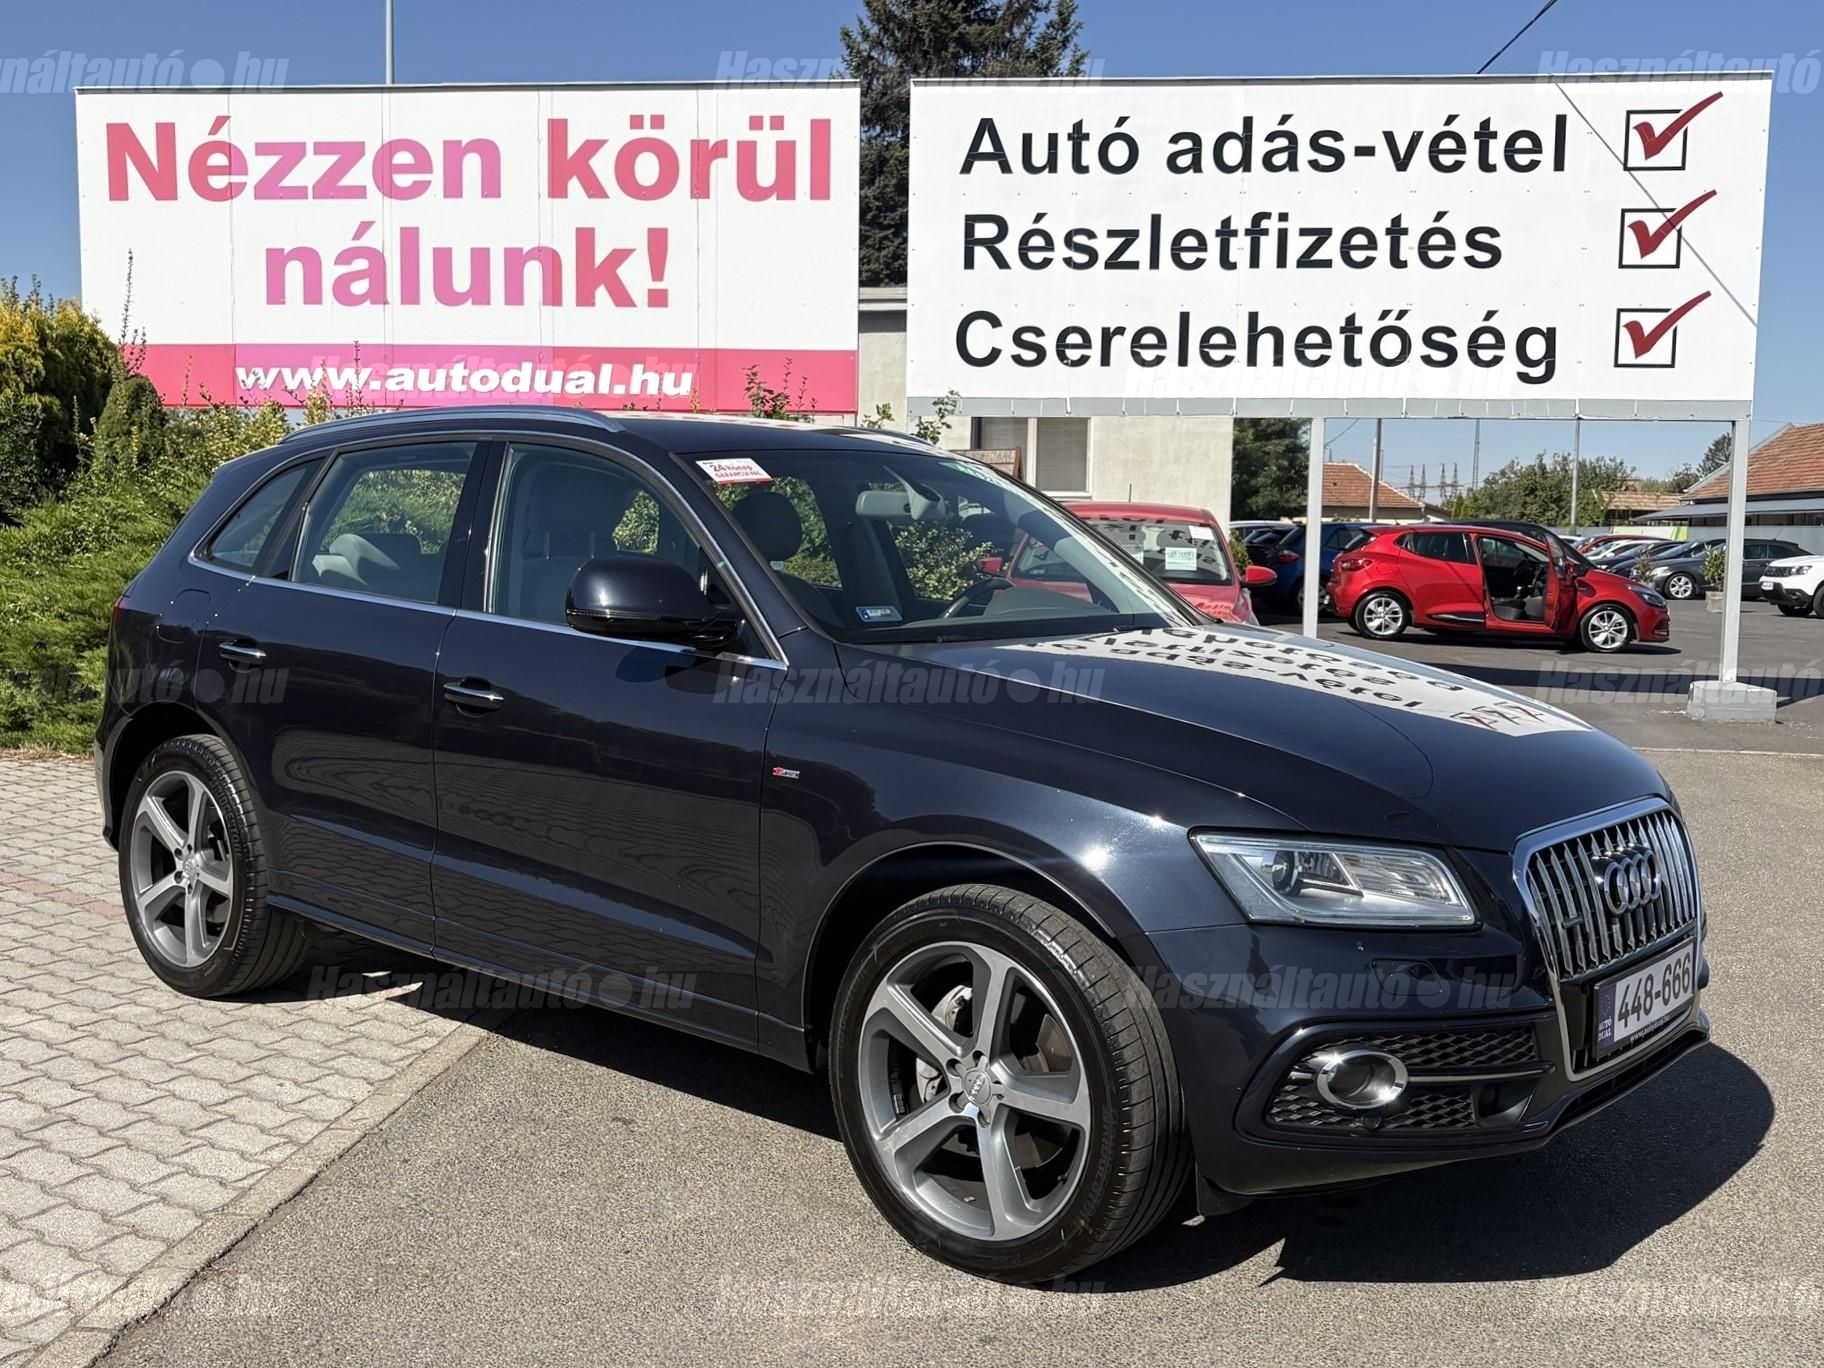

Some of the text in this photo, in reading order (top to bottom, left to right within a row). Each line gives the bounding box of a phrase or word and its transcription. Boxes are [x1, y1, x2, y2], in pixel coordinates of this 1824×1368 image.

[107, 115, 831, 201] Nézzen körül
[959, 114, 1567, 175] Autó adás-vétel
[267, 222, 668, 308] nálunk!
[964, 211, 1502, 271] Részletfizetés
[235, 361, 695, 396] www.autodual.hu
[956, 310, 1557, 384] Cserelehetőség
[1618, 952, 1691, 1028] 448-666
